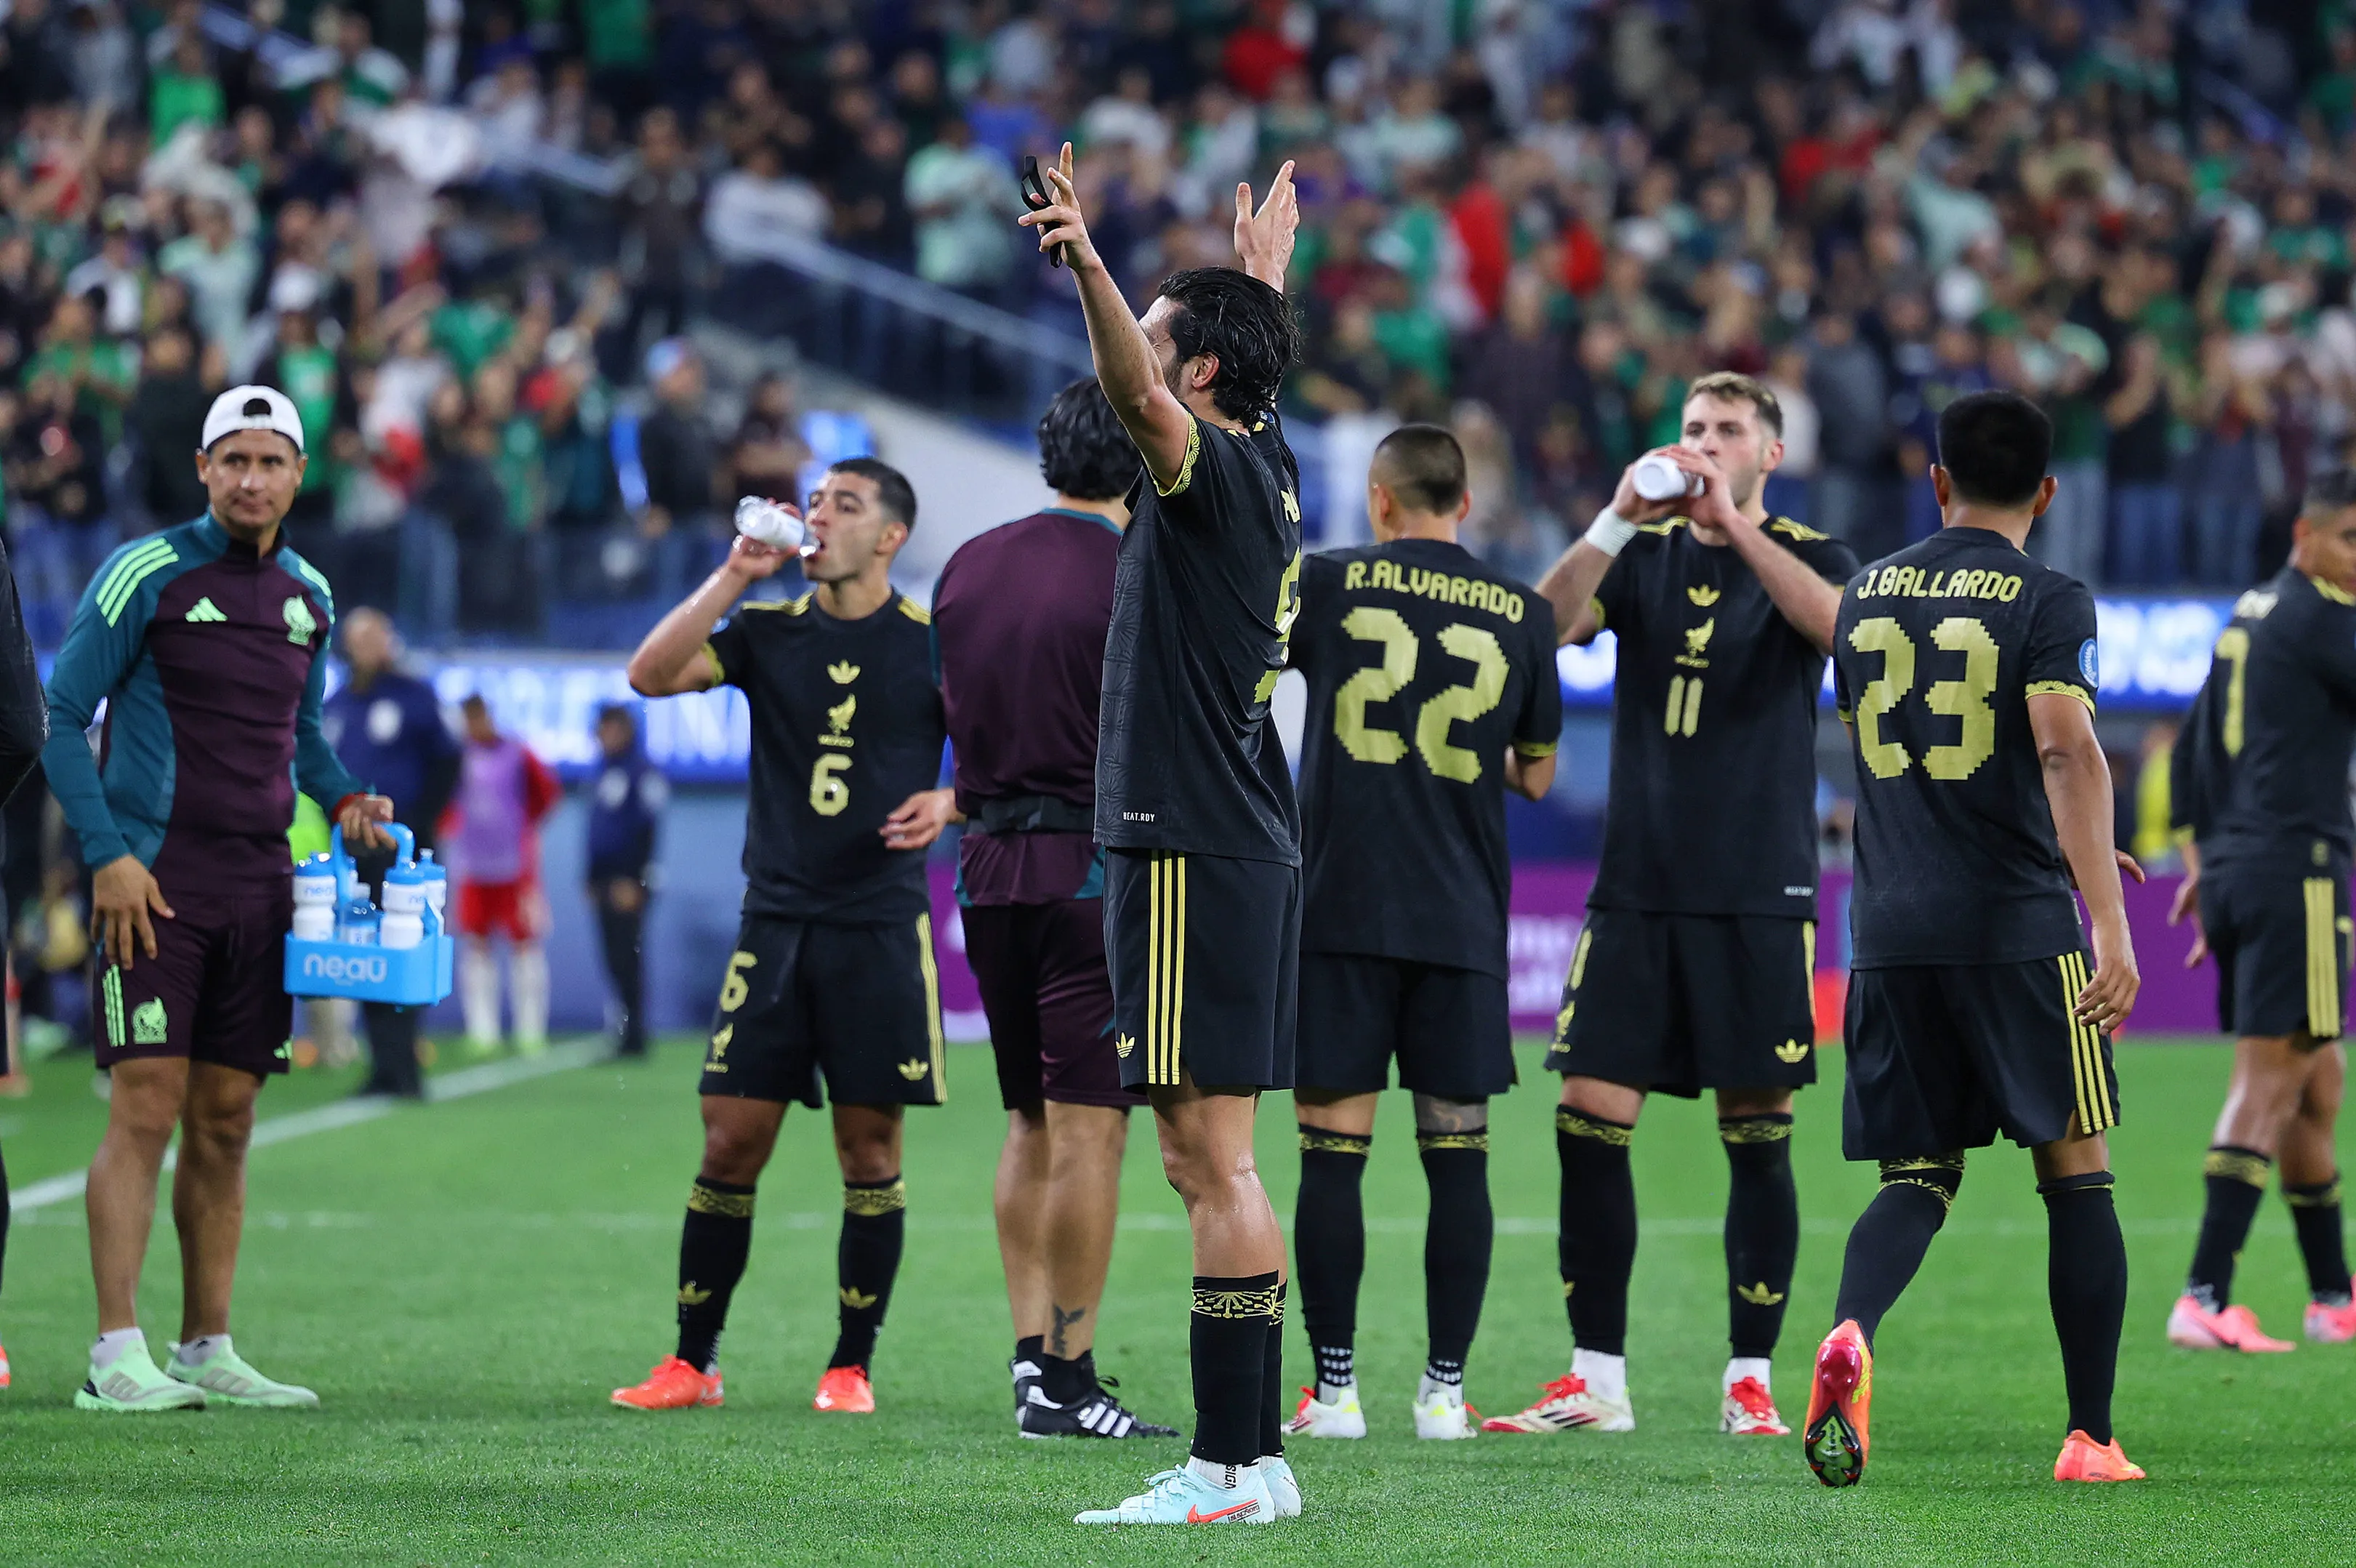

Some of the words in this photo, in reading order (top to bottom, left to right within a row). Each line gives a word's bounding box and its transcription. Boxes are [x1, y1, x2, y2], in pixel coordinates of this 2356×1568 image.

[1345, 559, 1525, 624] R.ALVARADO
[1857, 565, 2023, 603] J.GALLARDO
[1333, 606, 1511, 784] 22
[1663, 674, 1705, 739] 11
[1848, 616, 2000, 780] 23
[808, 752, 853, 816] 6
[1123, 811, 1155, 822] HEAT.RDY
[720, 950, 758, 1012] 6
